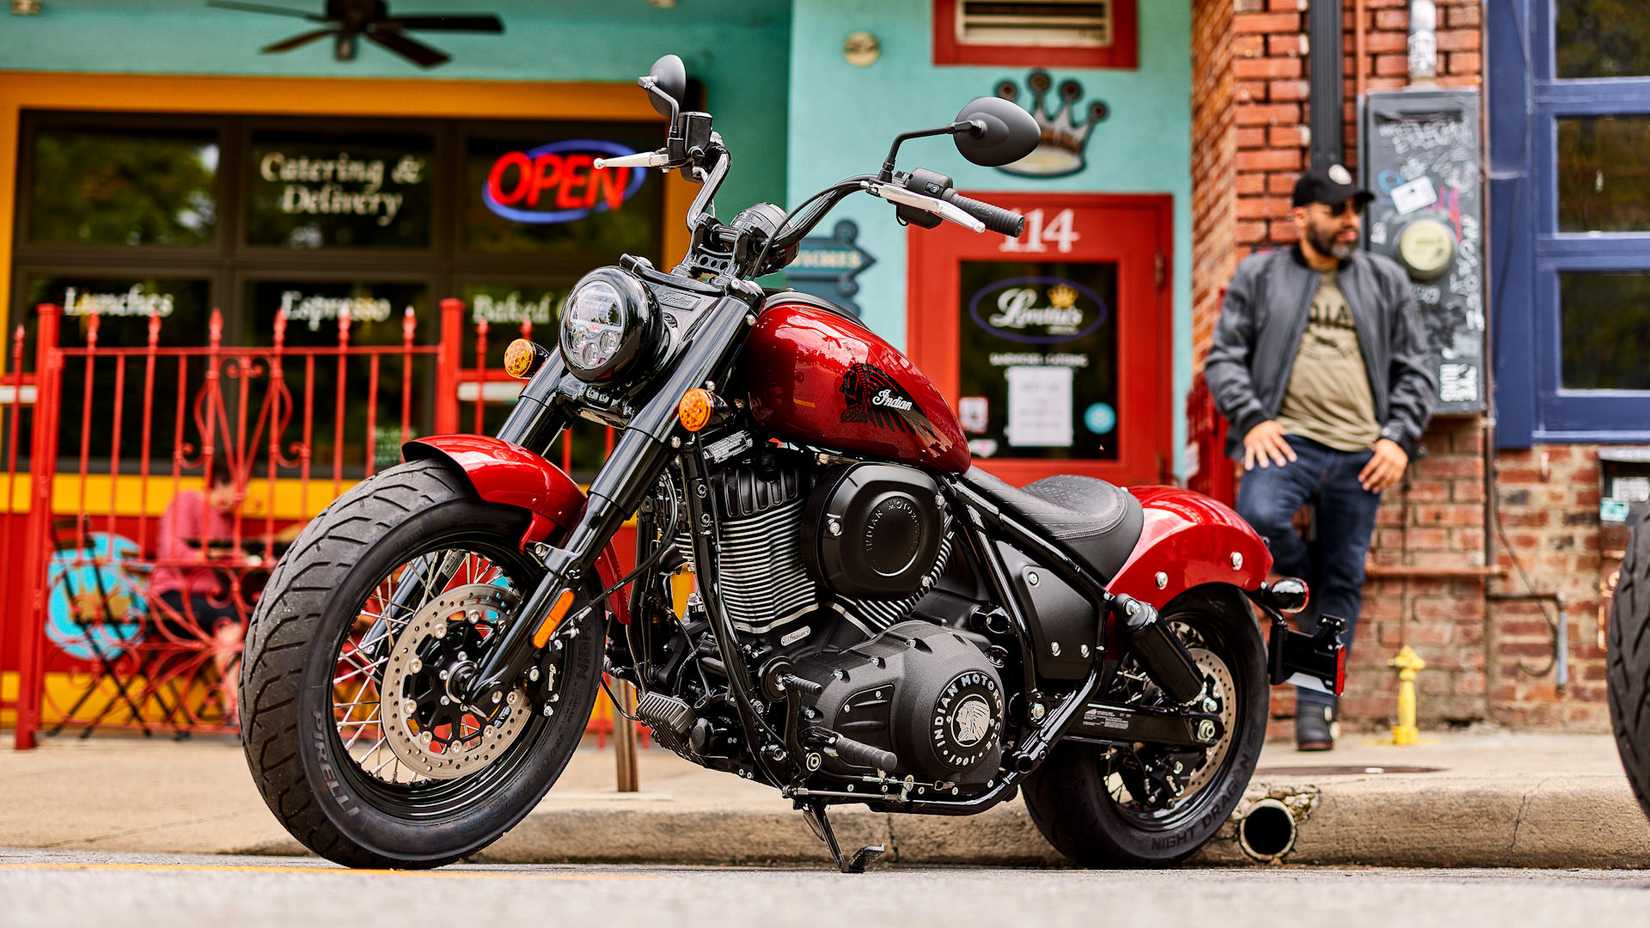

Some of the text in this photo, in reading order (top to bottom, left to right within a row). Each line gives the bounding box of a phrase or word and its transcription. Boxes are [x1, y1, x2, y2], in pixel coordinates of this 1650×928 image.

[260, 152, 425, 194] Catering &
[487, 151, 630, 212] OPEN
[281, 185, 403, 227] Delivery
[998, 207, 1082, 253] 114
[64, 283, 174, 317] Lunches
[281, 290, 392, 331] Espresso
[872, 389, 913, 411] Indian
[934, 682, 960, 748] INDIAN
[313, 710, 361, 817] PIRELLI
[948, 753, 976, 767] 1901
[1150, 827, 1195, 851] NIGHT
